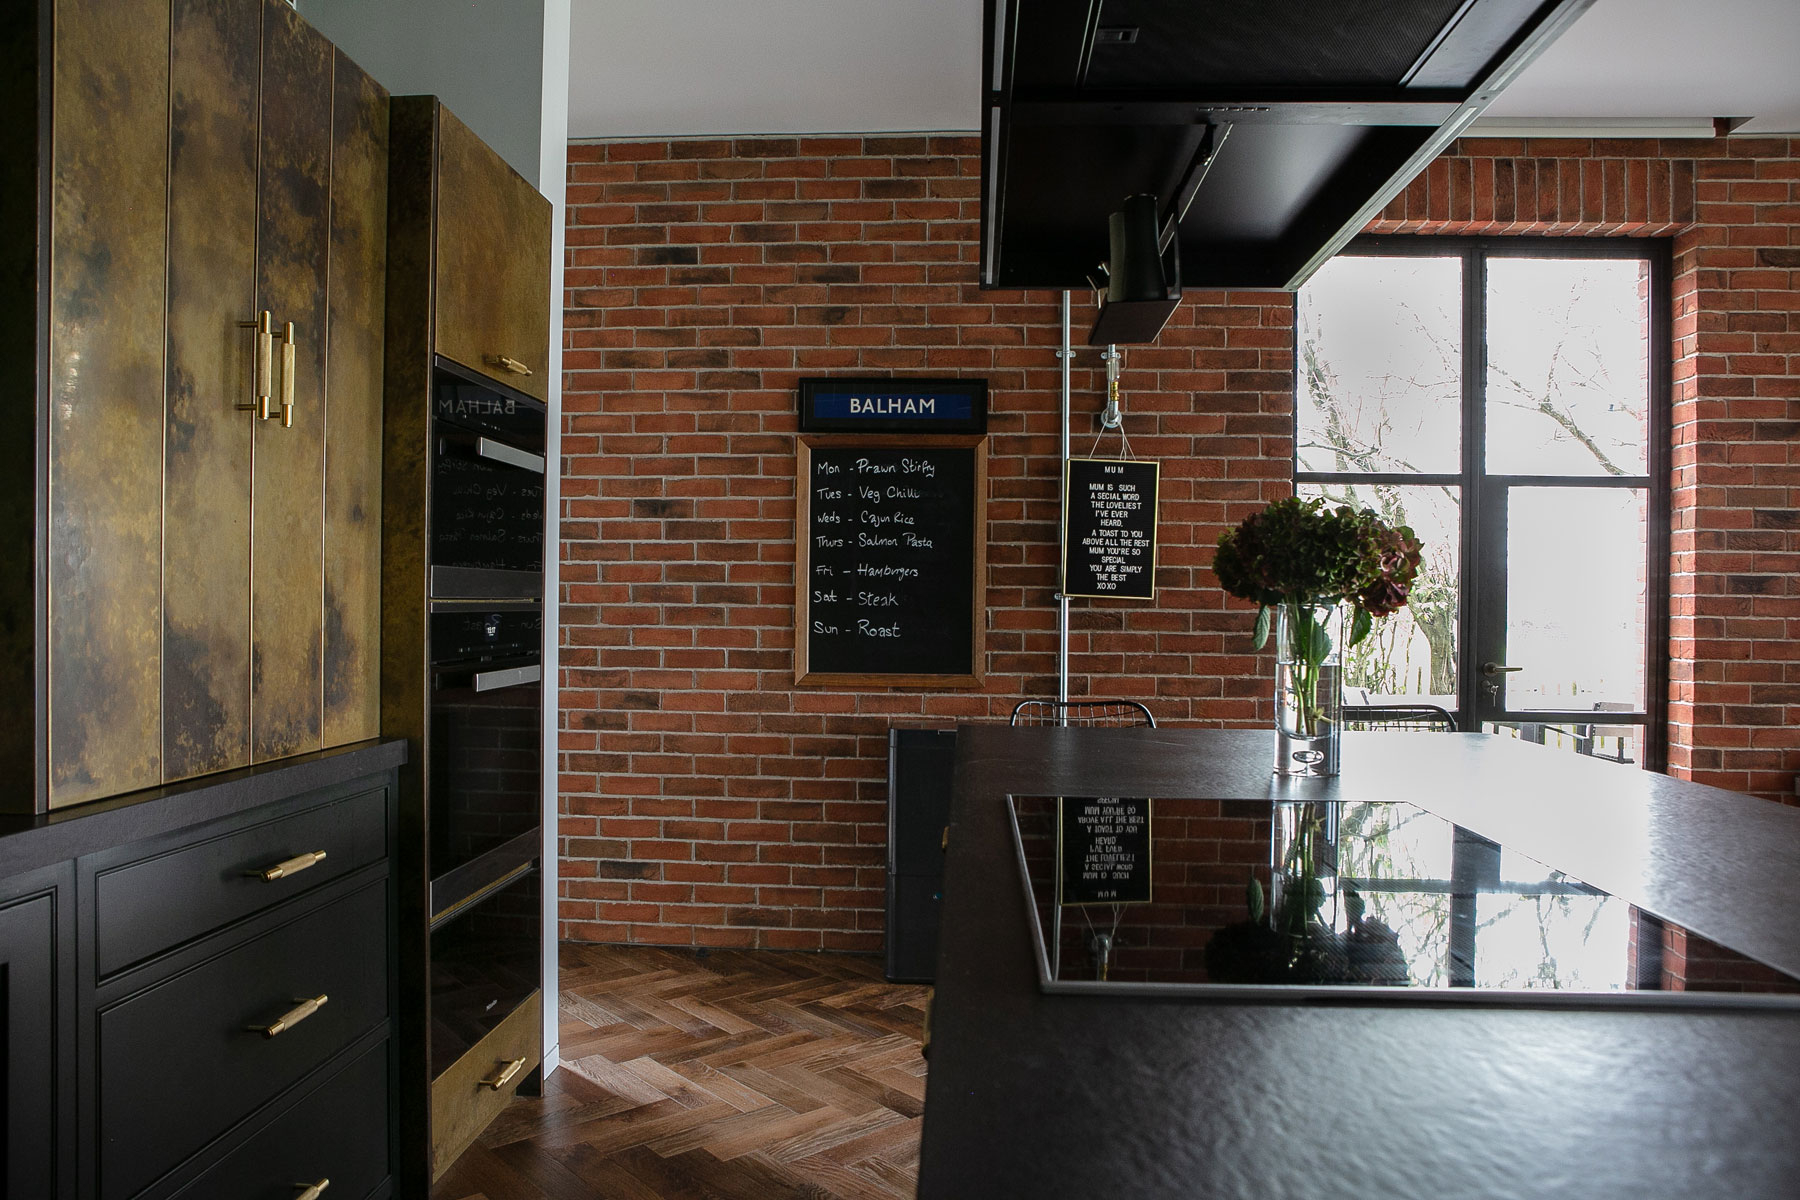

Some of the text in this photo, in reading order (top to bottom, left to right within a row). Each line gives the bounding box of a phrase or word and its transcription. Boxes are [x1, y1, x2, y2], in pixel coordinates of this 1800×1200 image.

[850, 398, 935, 414] BALHAM
[817, 462, 840, 474] Mon
[856, 458, 896, 474] Prawn
[817, 488, 842, 499] Tues
[860, 488, 880, 504] Veg
[1106, 502, 1142, 510] LOVELIEST
[817, 512, 841, 524] Weds
[861, 512, 891, 527] Cajun
[894, 513, 915, 525] Rice
[816, 536, 844, 548] Thurs
[859, 533, 898, 547] Salmon
[903, 533, 933, 549] Pasta
[1131, 530, 1142, 538] YOU
[816, 565, 833, 576] Fri
[857, 564, 919, 581] Hamburgers
[1097, 573, 1108, 581] THE
[814, 590, 838, 603] Sat
[858, 592, 899, 606] Steak
[814, 622, 839, 635] Sun
[858, 620, 901, 638] Roast
